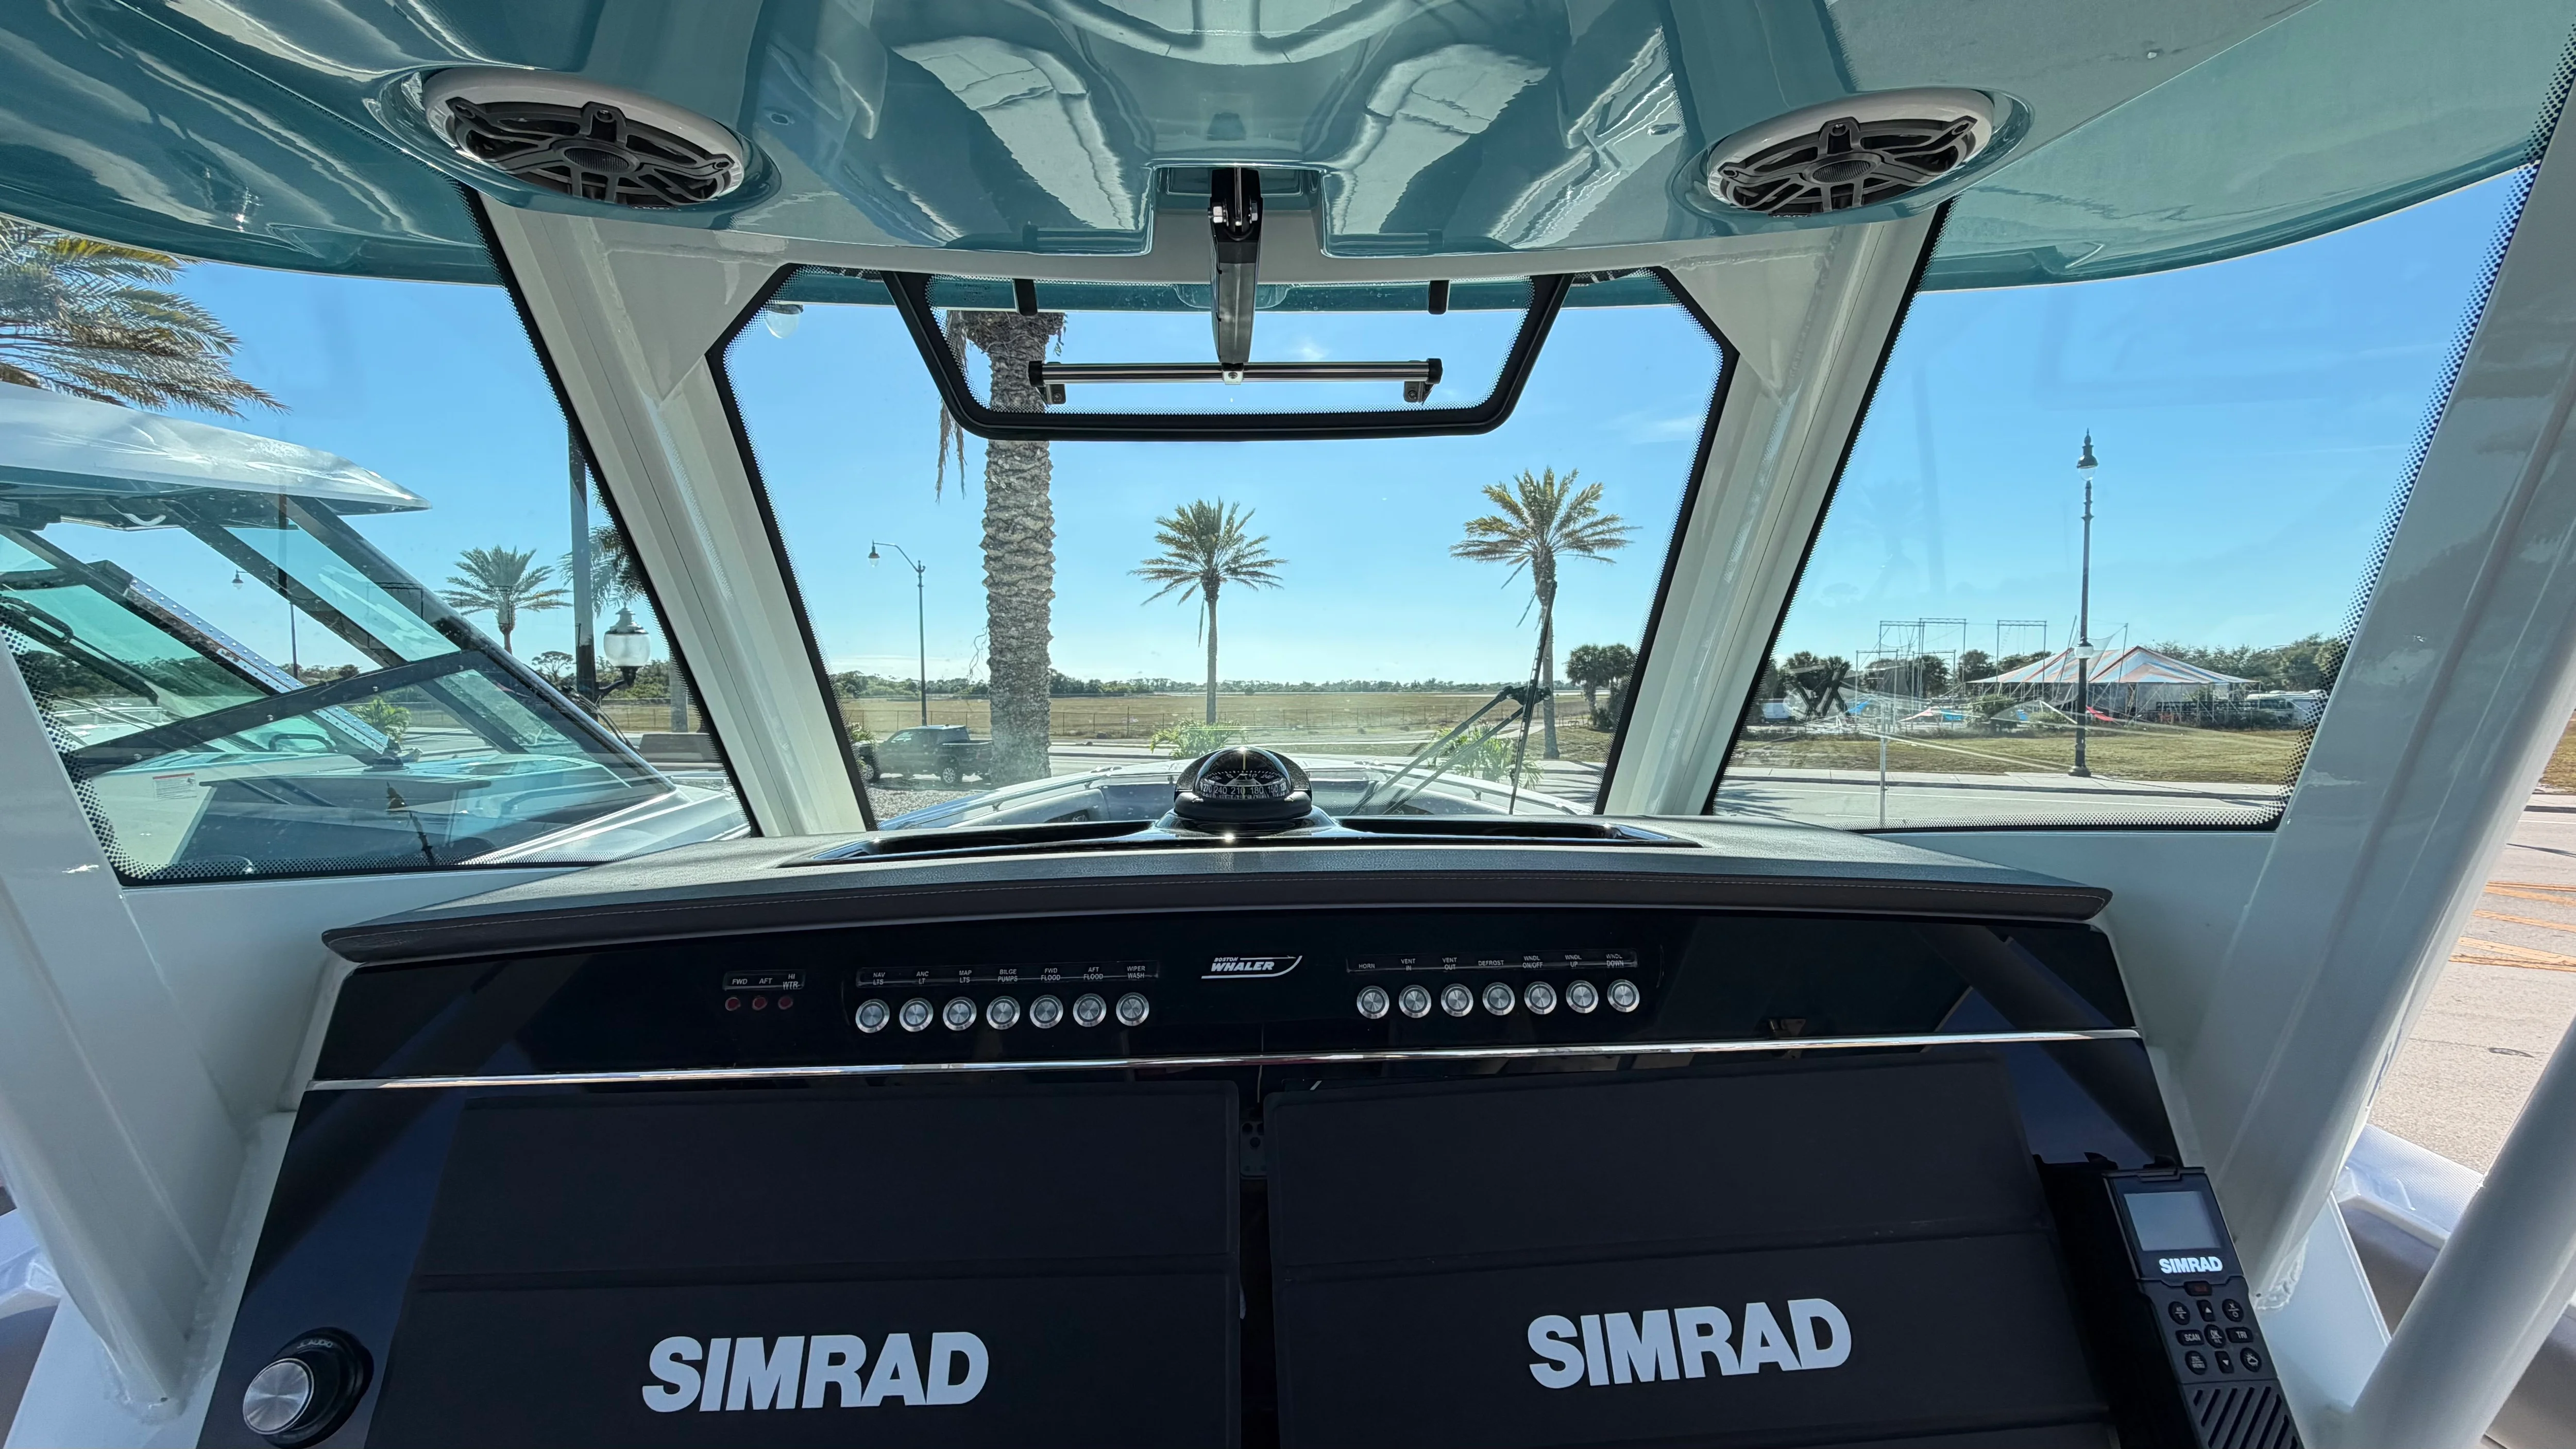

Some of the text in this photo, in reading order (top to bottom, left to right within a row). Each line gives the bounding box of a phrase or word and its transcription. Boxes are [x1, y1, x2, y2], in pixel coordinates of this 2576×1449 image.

[1203, 783, 1212, 793] 270
[1214, 786, 1227, 794] 240
[1231, 786, 1246, 794] 210
[1250, 786, 1264, 794] 180
[1267, 784, 1278, 793] 150
[1211, 961, 1275, 972] WHALER
[783, 981, 799, 990] WTR
[2159, 1256, 2223, 1274] SIMRAD
[1528, 1298, 1852, 1389] SIMRAD
[642, 1332, 989, 1412] SIMRAD
